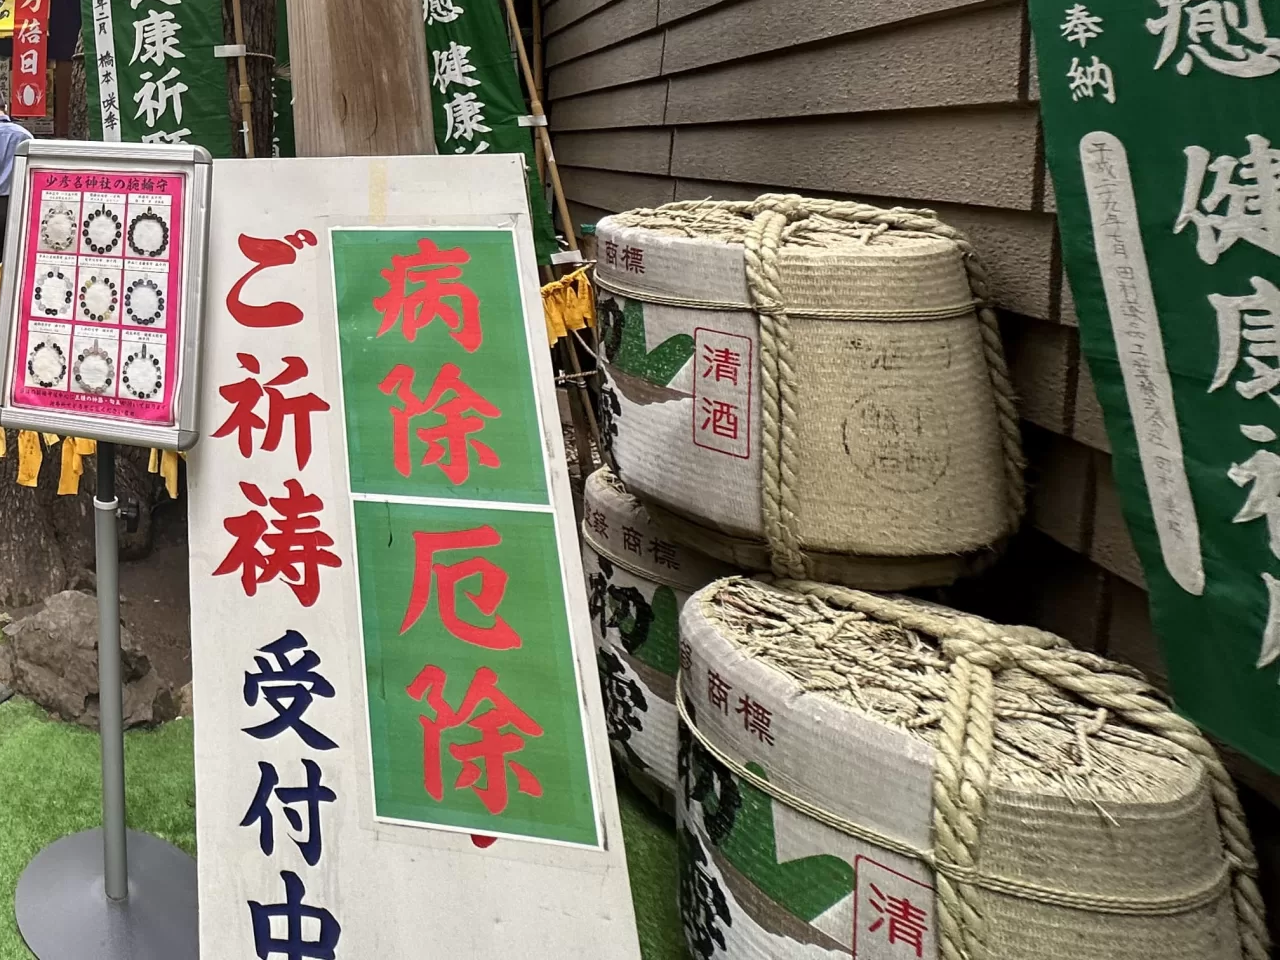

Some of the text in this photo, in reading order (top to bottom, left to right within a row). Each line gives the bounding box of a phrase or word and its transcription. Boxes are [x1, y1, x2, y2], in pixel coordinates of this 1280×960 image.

[1060, 3, 1117, 104] 奉納
[605, 240, 646, 274] 商標
[373, 238, 501, 486] 病除
[701, 343, 741, 440] 清酒
[400, 524, 544, 816] 厄除
[707, 668, 776, 747] 商標
